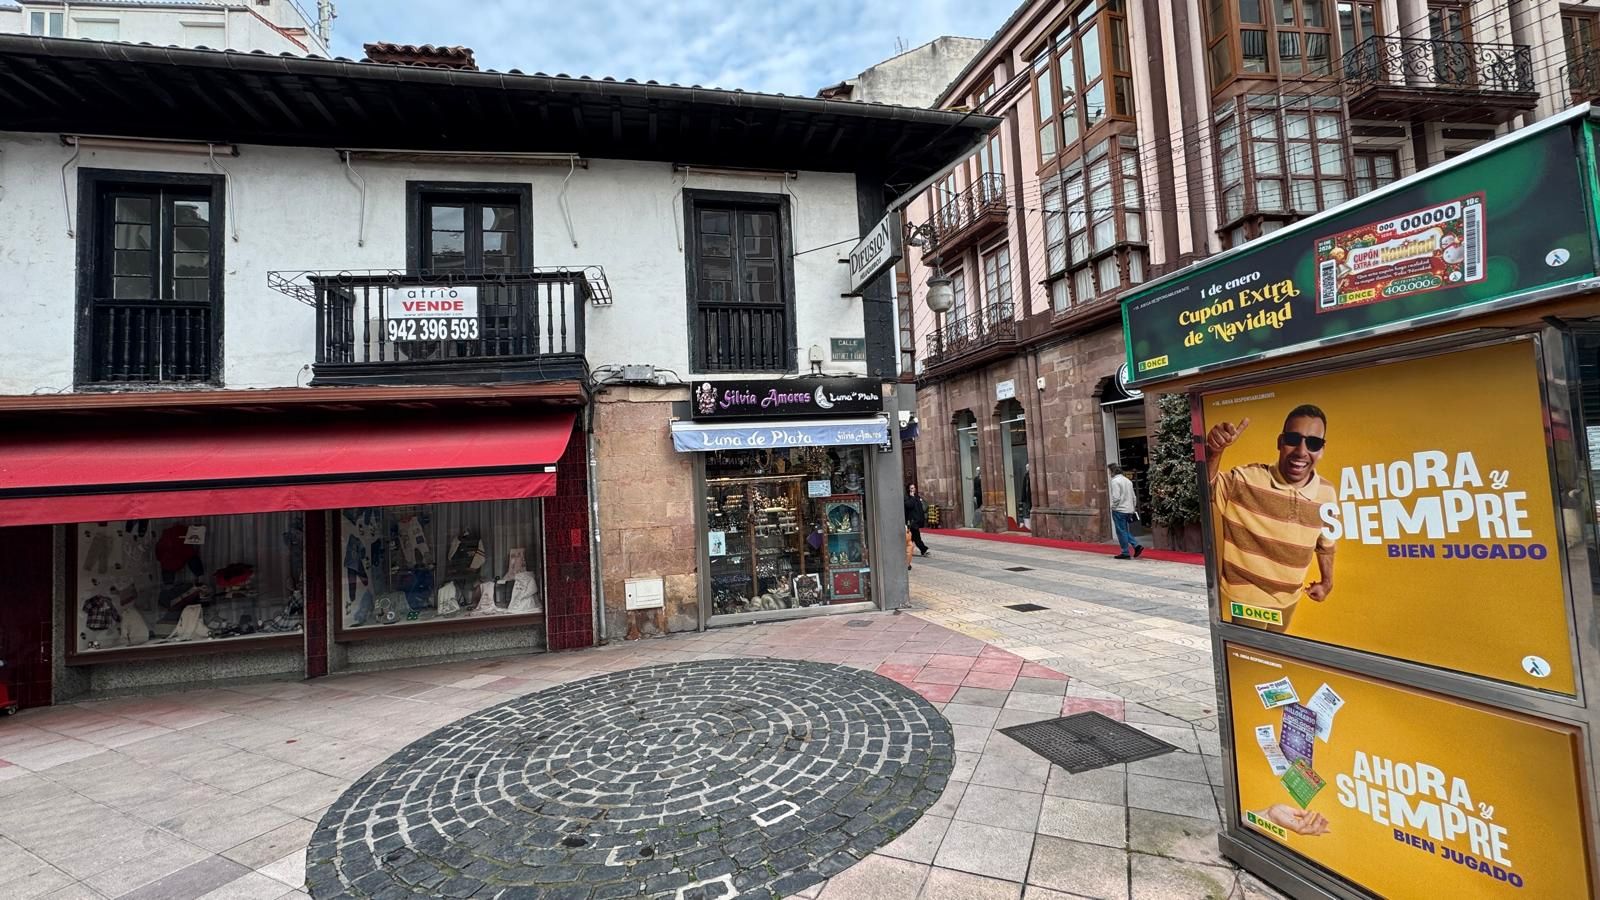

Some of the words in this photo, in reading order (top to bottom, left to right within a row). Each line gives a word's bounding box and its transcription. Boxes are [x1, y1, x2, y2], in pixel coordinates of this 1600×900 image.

[1378, 222, 1394, 231] 000
[1400, 205, 1456, 231] 00000
[850, 218, 889, 275] DIFUSION
[1354, 249, 1379, 262] CUPÓN
[1354, 261, 1372, 270] EXTRA
[1200, 288, 1206, 299] 1
[1208, 284, 1223, 296] de
[1225, 271, 1261, 290] enero
[1385, 278, 1441, 294] 400.000€
[1179, 299, 1234, 326] Cupón
[1238, 279, 1300, 307] Extra
[1348, 290, 1373, 301] ONCE
[402, 300, 464, 311] VENDE
[388, 319, 416, 341] 942
[420, 318, 447, 340] 396
[451, 318, 478, 339] 593
[1184, 330, 1203, 347] de
[1208, 302, 1292, 342] Navidad
[1146, 357, 1167, 368] ONCE
[719, 389, 757, 408] Silvia
[760, 389, 811, 408] Amores
[829, 393, 852, 401] Luna
[857, 392, 879, 401] Plata
[702, 431, 742, 447] Luna
[747, 431, 765, 445] de
[771, 430, 812, 445] Plata
[835, 430, 855, 443] Silvia
[855, 429, 882, 442] Amores
[1339, 450, 1483, 500] AHORA
[1489, 470, 1509, 489] y
[1319, 489, 1533, 545] SIEMPRE
[1388, 544, 1435, 558] BIEN
[1442, 543, 1547, 560] JUGADO
[1245, 607, 1279, 622] ONCE
[1353, 750, 1474, 811] AHORA
[1478, 802, 1495, 820] y
[1257, 818, 1285, 837] ONCE
[1335, 773, 1512, 867] SIEMPRE
[1393, 828, 1435, 854] BIEN
[1441, 846, 1524, 888] JUGADO
